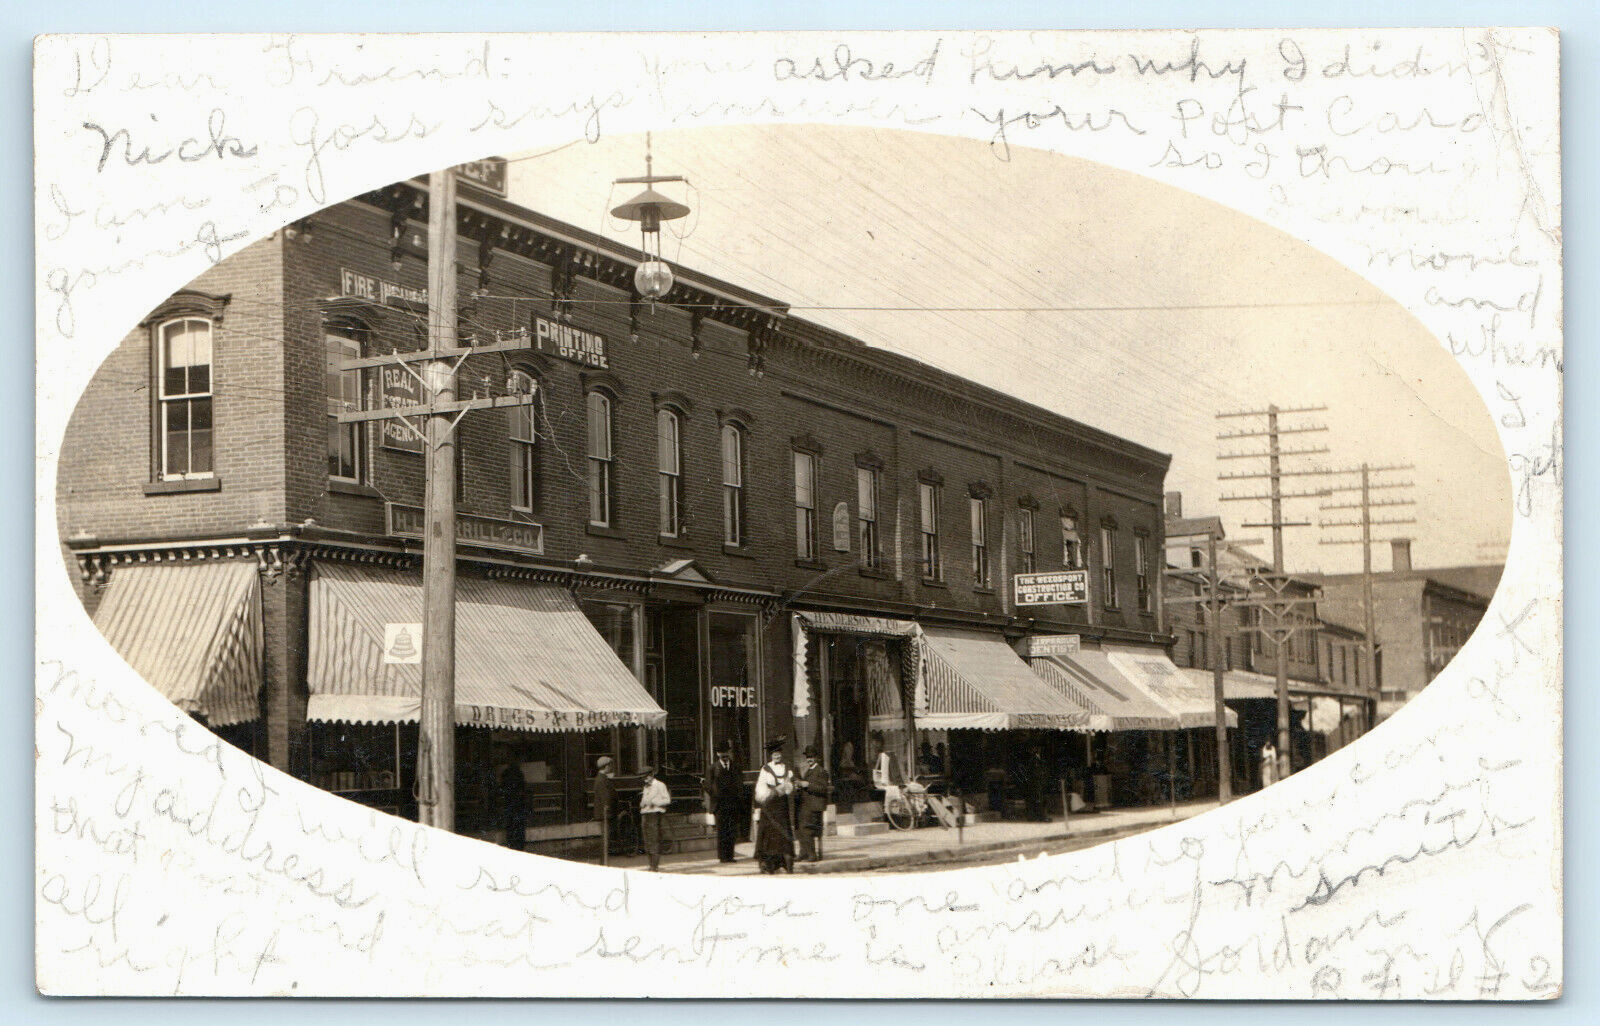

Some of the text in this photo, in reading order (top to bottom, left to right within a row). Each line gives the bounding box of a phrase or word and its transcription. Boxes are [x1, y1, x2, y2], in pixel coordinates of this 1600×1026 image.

[773, 37, 943, 86] asked
[344, 270, 376, 300] FIRE
[536, 317, 604, 356] PRINTING
[560, 346, 609, 369] OFFICE
[384, 368, 415, 394] REAL
[1018, 583, 1072, 594] CONSTRUCTION
[1019, 576, 1035, 585] THE
[471, 704, 536, 725] DRUGS
